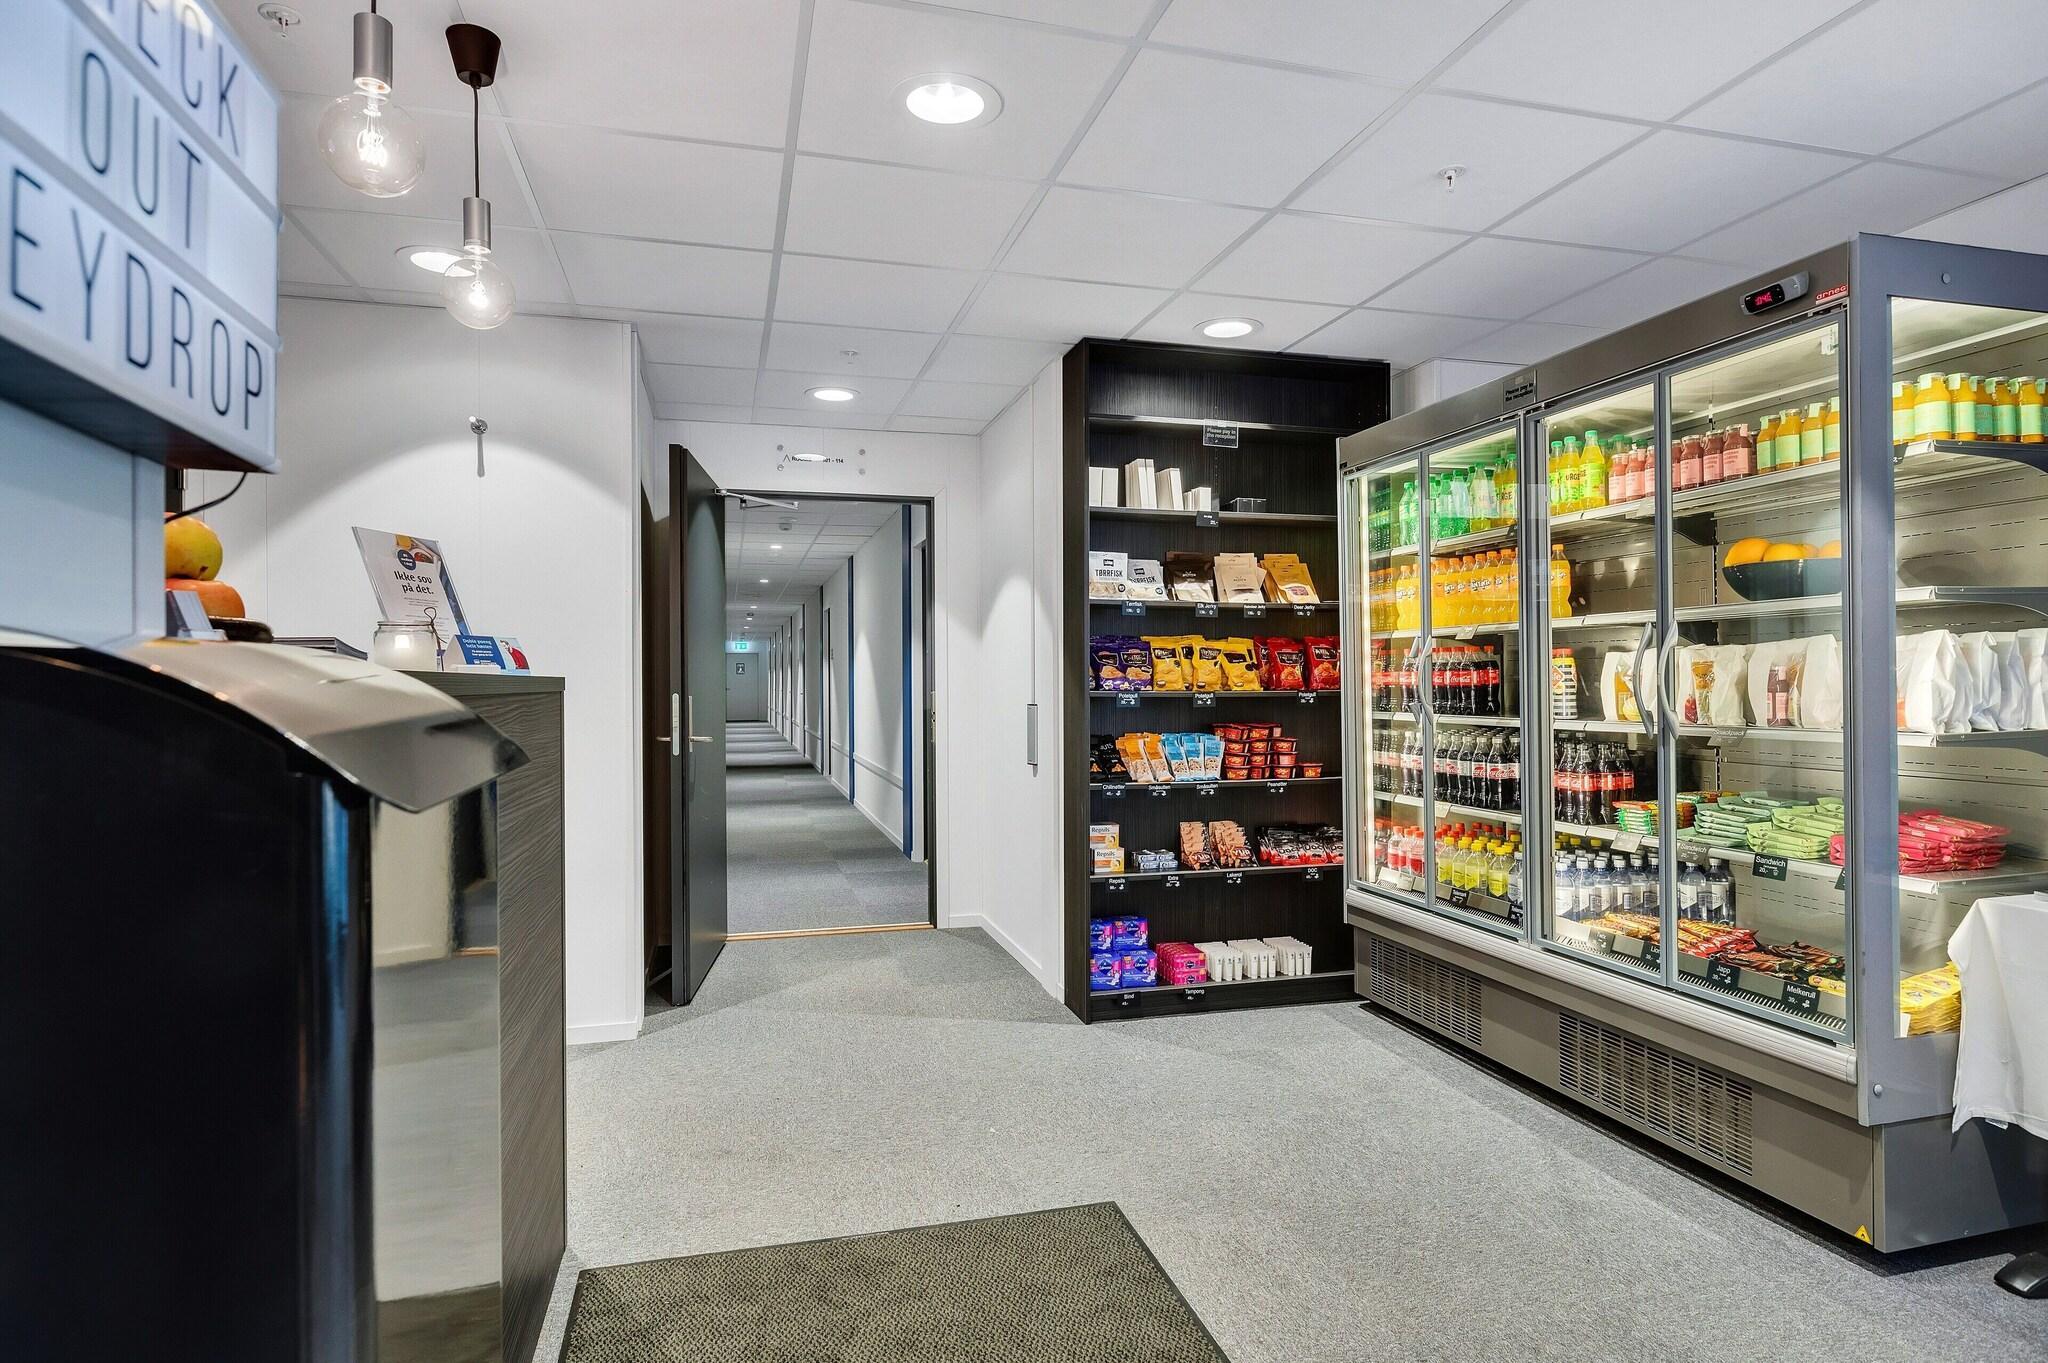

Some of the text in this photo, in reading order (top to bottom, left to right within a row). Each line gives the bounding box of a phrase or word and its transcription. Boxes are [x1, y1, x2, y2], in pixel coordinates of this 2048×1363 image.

[81, 51, 202, 249] OUT
[10, 167, 263, 430] EYDROP
[393, 570, 416, 583] Ikke
[1095, 569, 1123, 578] TØRRFISK
[401, 582, 434, 595] på det.
[1680, 843, 1707, 854] Sandwich
[1755, 855, 1786, 868] Sandwich
[1716, 965, 1731, 974] Japp
[1786, 984, 1817, 999] Melkerull
